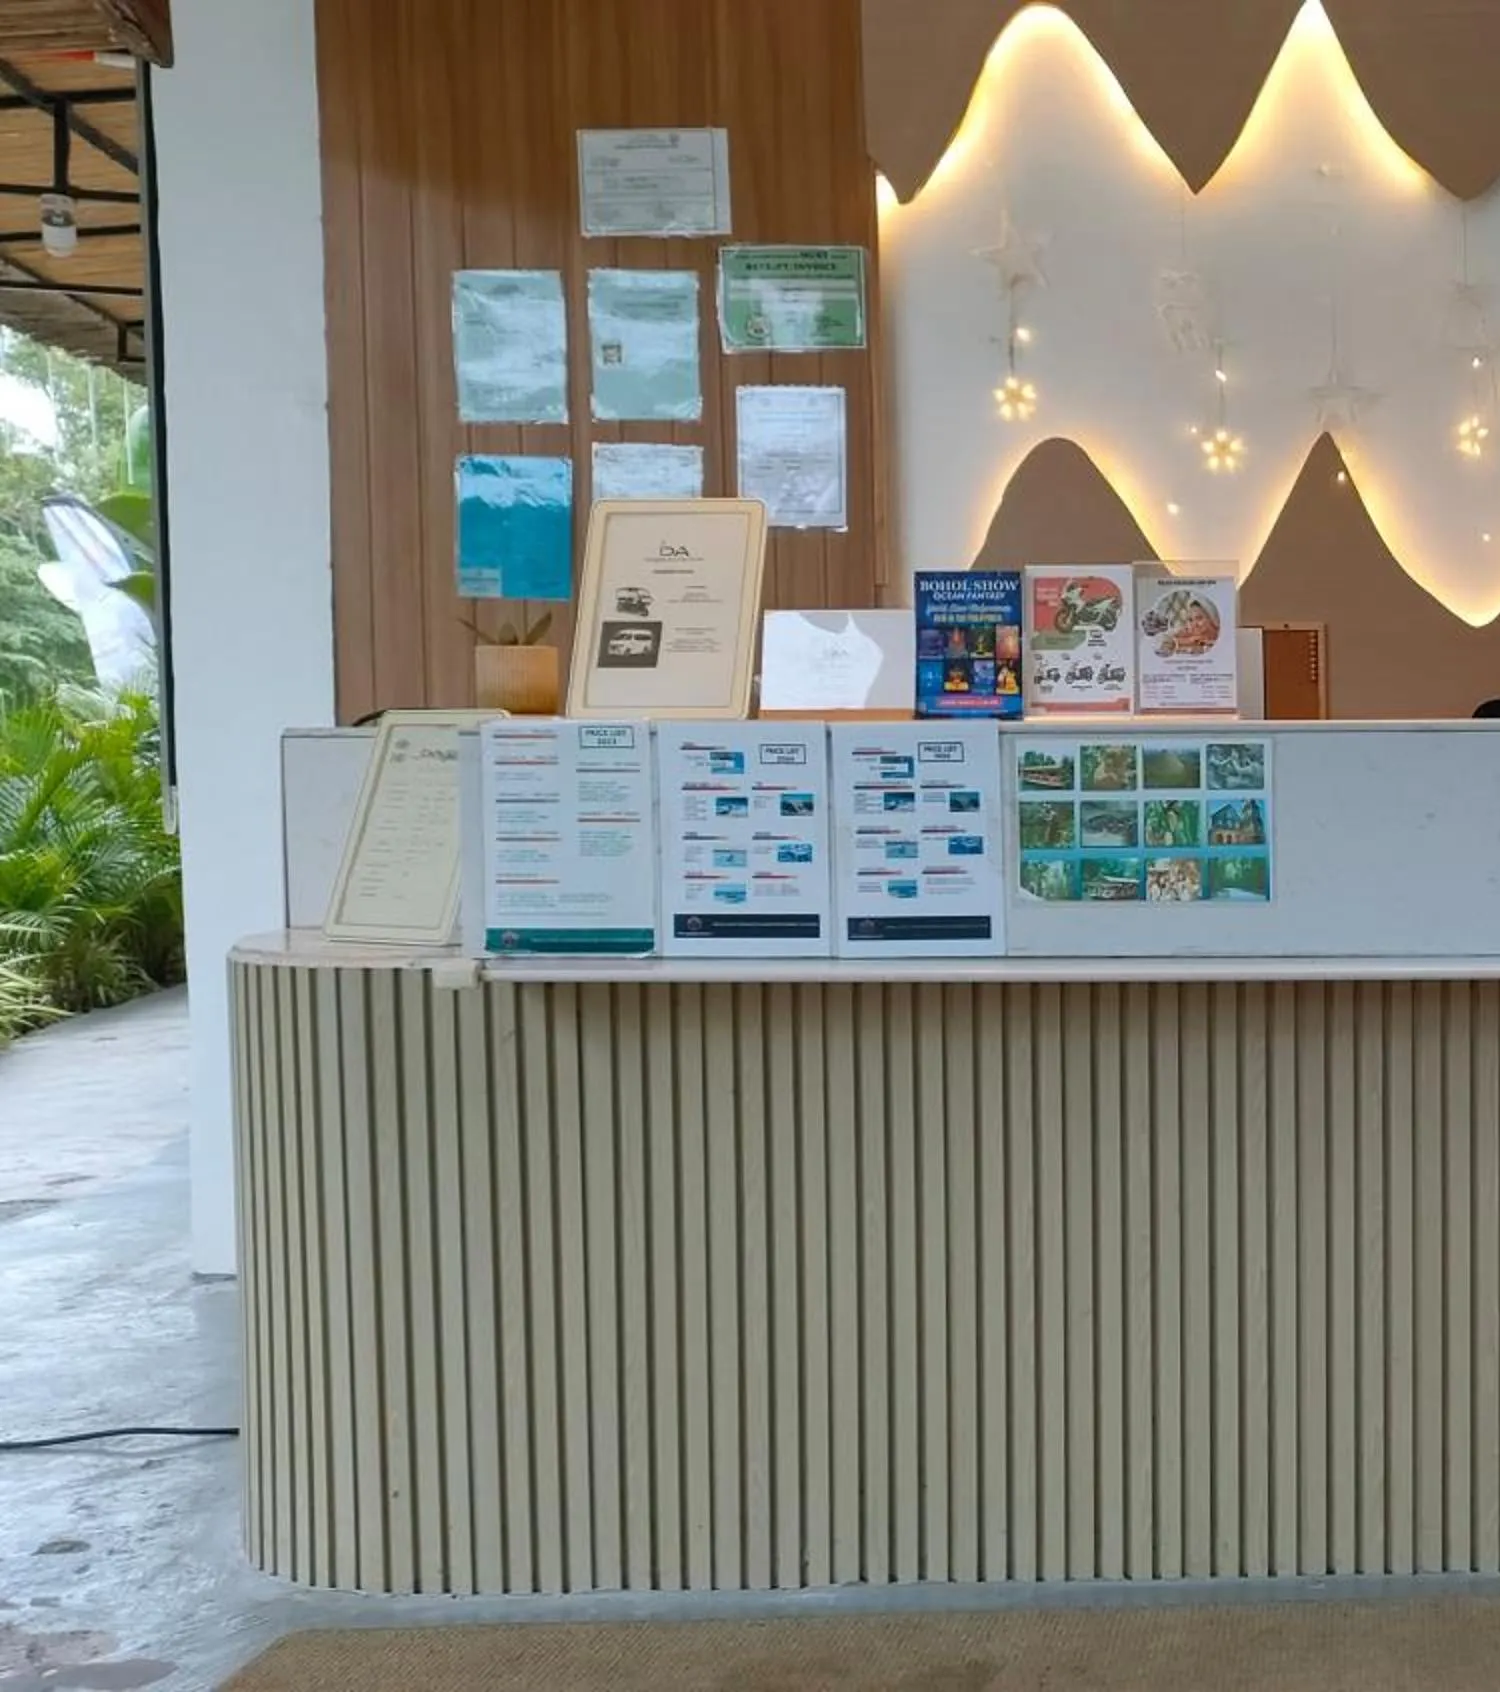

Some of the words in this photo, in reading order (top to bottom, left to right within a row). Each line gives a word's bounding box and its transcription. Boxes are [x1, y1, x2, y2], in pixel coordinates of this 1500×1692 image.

[920, 580, 970, 591] BOHOL
[974, 580, 1019, 591] SHOW
[933, 592, 965, 601] OCEAN
